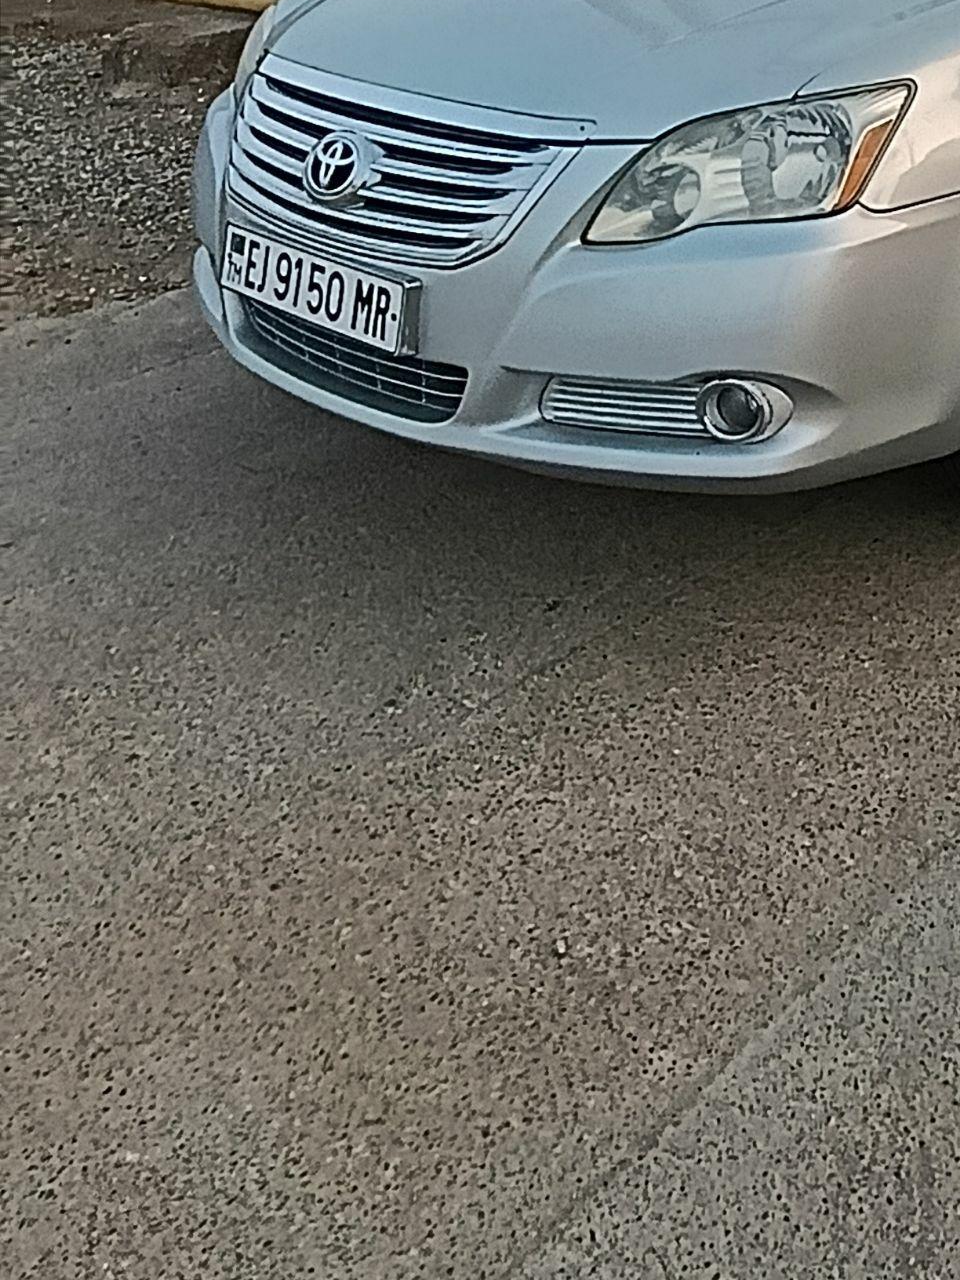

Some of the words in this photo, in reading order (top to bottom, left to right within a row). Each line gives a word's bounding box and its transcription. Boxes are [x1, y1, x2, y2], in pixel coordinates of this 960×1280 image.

[244, 239, 270, 293] EJ
[273, 252, 345, 322] 9150
[350, 278, 391, 342] MR
